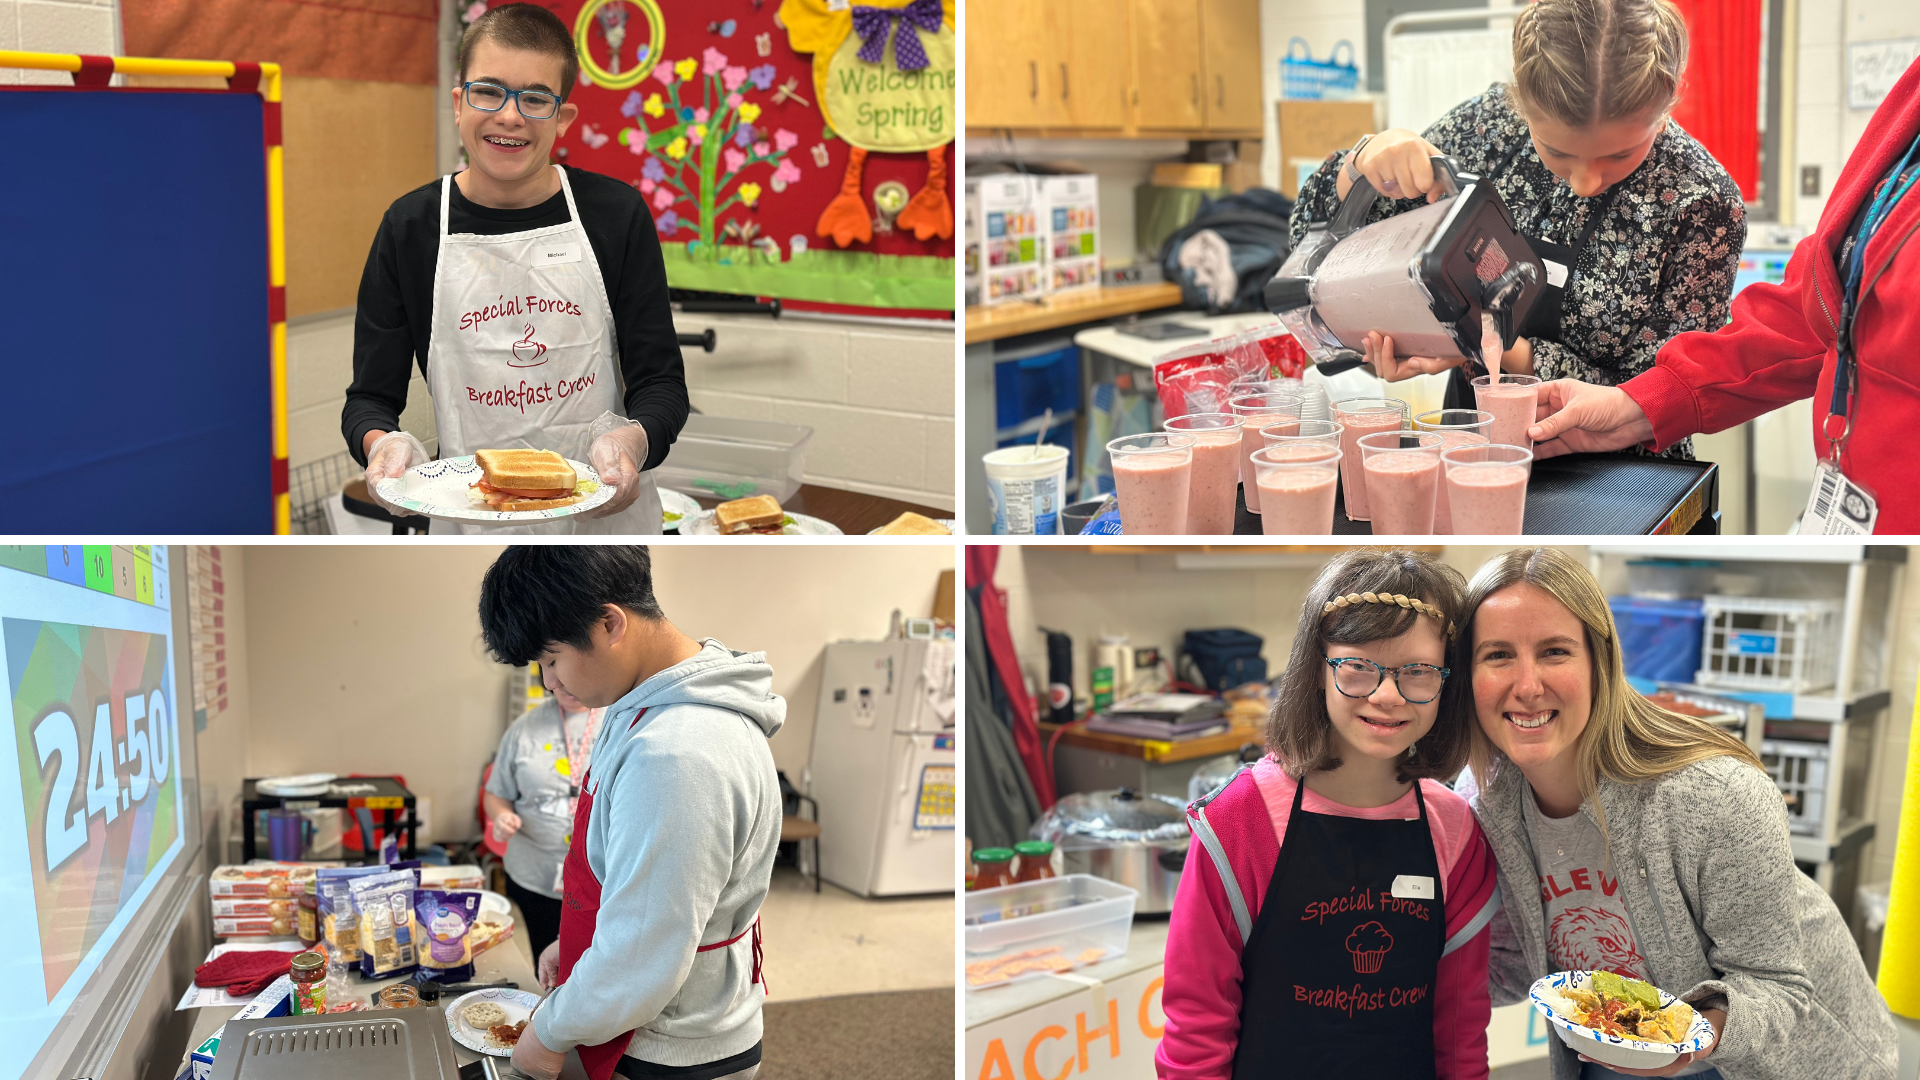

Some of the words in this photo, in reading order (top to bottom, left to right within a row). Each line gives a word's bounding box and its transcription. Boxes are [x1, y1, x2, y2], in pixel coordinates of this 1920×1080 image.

[839, 64, 955, 95] Welcome
[856, 102, 943, 139] Spring
[459, 295, 523, 332] Special
[525, 296, 581, 316] Forces
[466, 380, 553, 414] Breakfast
[557, 373, 596, 398] Crew
[94, 554, 104, 579] 10
[122, 566, 127, 586] 5
[143, 576, 147, 593] 6
[33, 688, 170, 874] 24:50
[1301, 886, 1375, 925] Special
[1380, 892, 1429, 921] Forces
[1293, 983, 1386, 1019] Breakfast
[1389, 984, 1428, 1007] Crew
